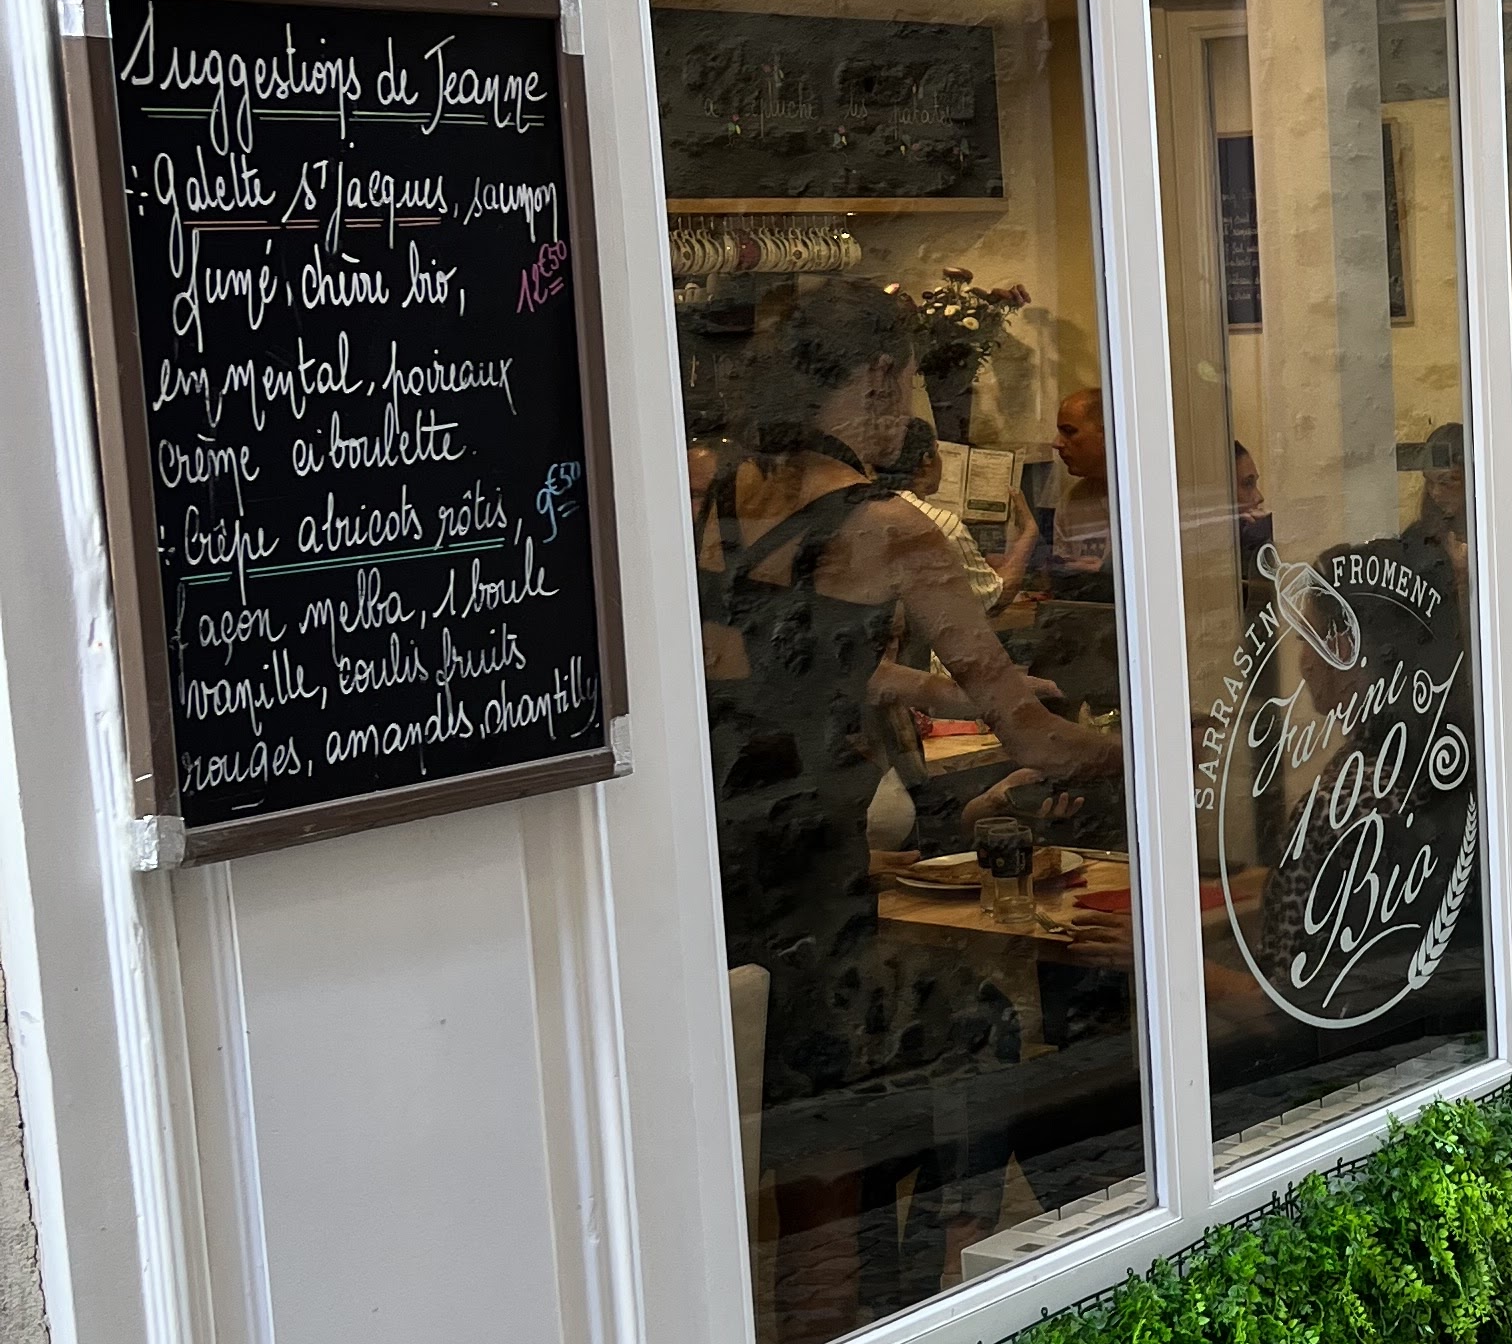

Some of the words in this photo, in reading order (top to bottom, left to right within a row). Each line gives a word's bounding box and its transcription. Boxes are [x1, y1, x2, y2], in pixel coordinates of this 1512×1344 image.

[121, 0, 361, 155] Suggestions
[376, 36, 419, 106] de
[420, 34, 548, 135] Jeanne
[382, 340, 518, 434] poireaux
[298, 484, 423, 553] abricots
[461, 536, 561, 620] boule
[1333, 554, 1442, 617] FROMENT
[1194, 601, 1282, 811] SARRASIN
[1248, 656, 1408, 798] Farine
[1291, 806, 1439, 990] Bio
